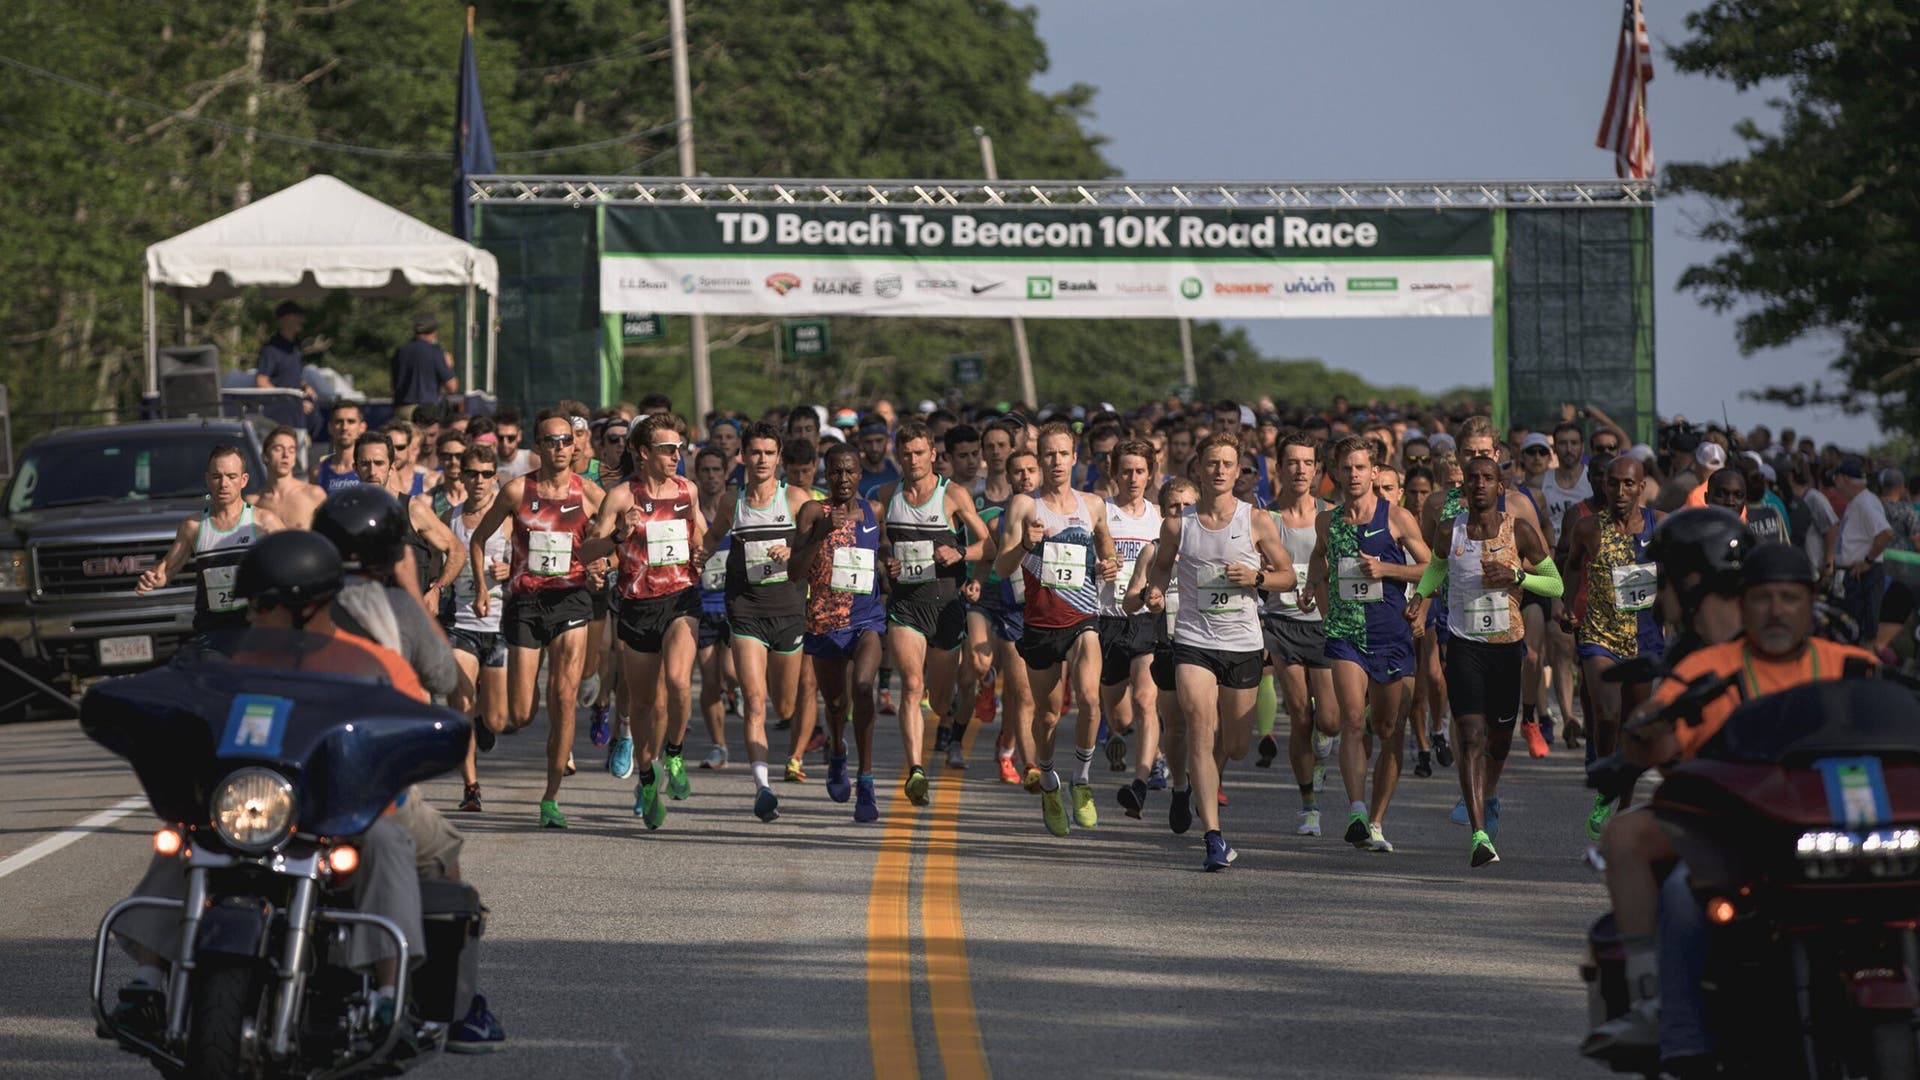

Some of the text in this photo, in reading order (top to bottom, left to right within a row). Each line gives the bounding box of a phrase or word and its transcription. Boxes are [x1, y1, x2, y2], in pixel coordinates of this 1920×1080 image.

[716, 212, 1377, 247] TD Beach To Beacon 10K Road Race
[1030, 279, 1097, 298] TD Bank
[665, 545, 674, 557] 2
[83, 554, 157, 576] GMC
[541, 556, 557, 567] 21
[763, 565, 771, 575] 8
[906, 564, 923, 576] 10
[1055, 568, 1073, 581] 13
[850, 573, 858, 585] 1
[1351, 583, 1369, 595] 19
[1210, 593, 1229, 605] 20
[1629, 589, 1646, 602] 16
[1482, 615, 1493, 628] 9
